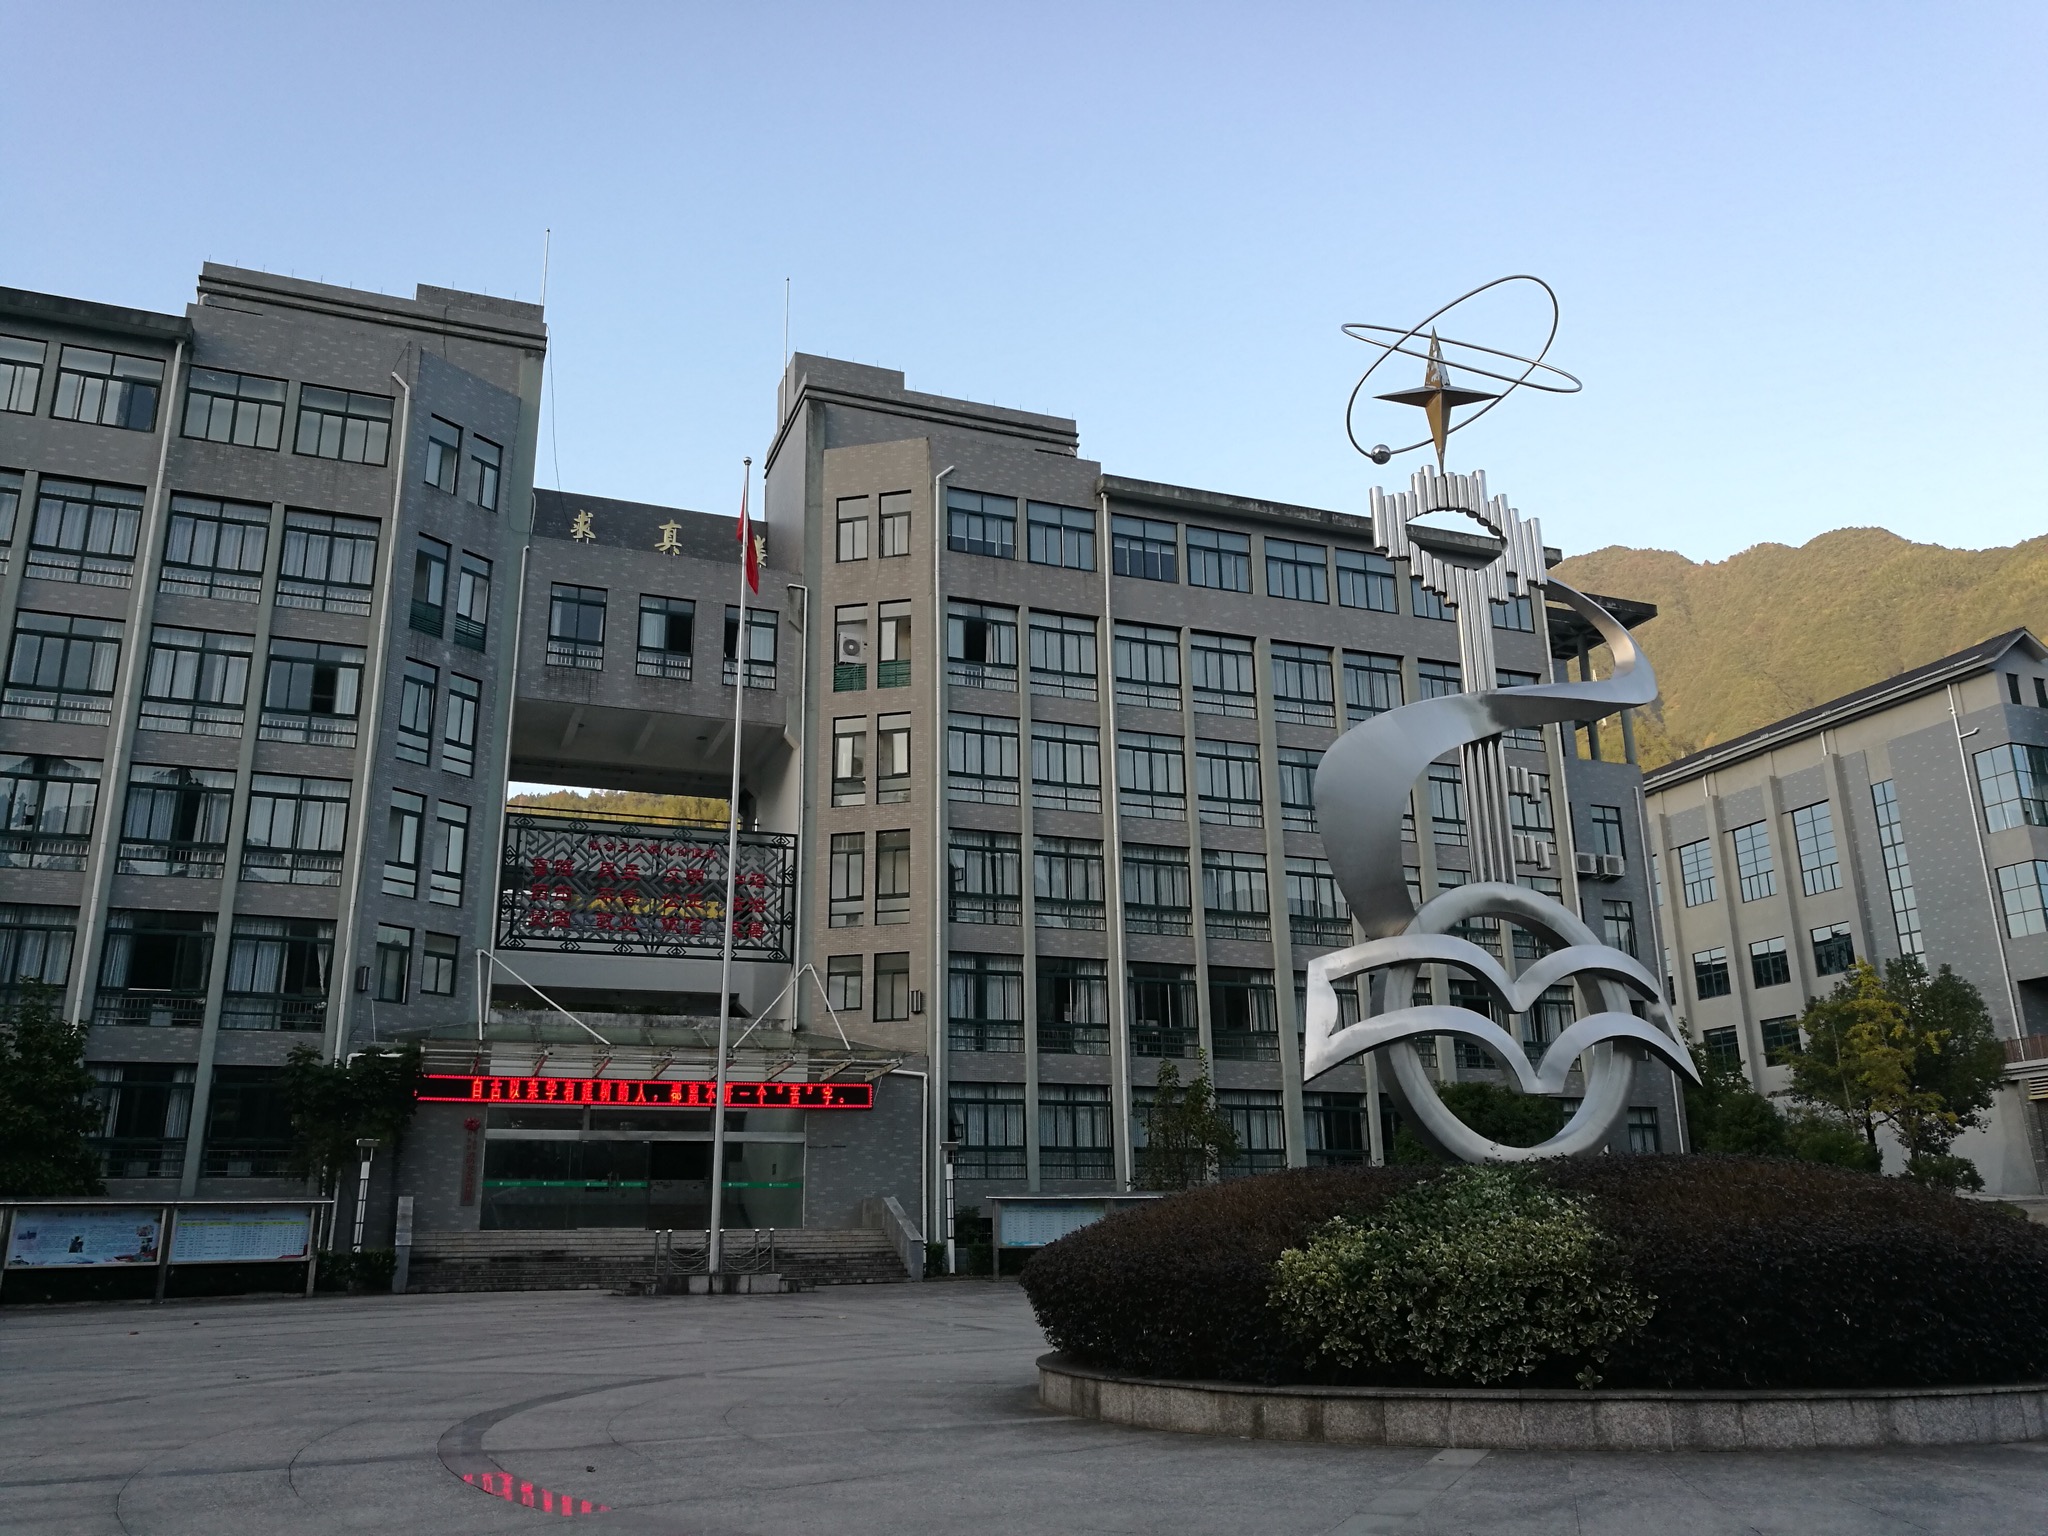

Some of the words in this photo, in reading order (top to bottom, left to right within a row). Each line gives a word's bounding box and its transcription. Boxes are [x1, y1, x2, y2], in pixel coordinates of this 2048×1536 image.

[531, 856, 575, 877] 富强
[598, 861, 641, 881] 民主
[663, 867, 705, 886] 文明
